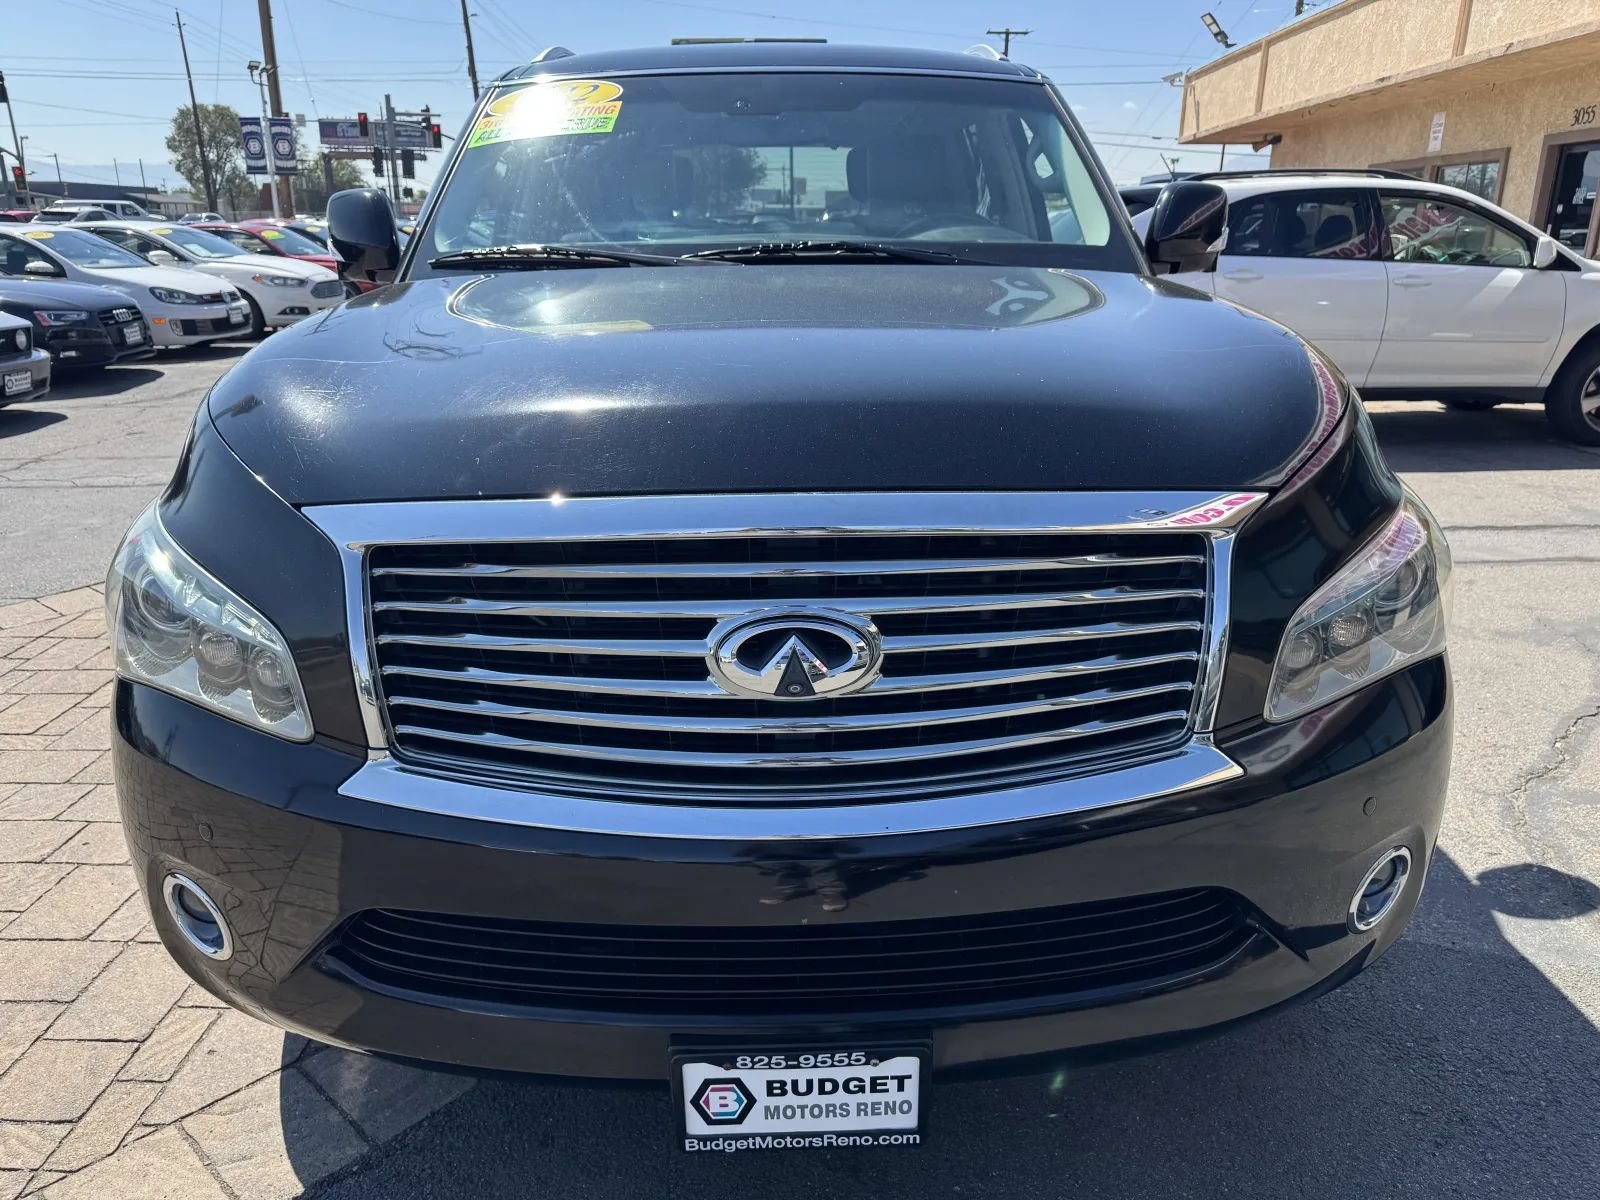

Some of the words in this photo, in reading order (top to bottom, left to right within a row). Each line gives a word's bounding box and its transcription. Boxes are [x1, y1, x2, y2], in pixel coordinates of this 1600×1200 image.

[570, 104, 616, 116] ATING
[1570, 104, 1597, 126] 3055
[735, 1052, 866, 1069] 825-9555
[766, 1075, 912, 1097] BUDGET
[764, 1103, 851, 1120] MOTORS
[856, 1099, 913, 1117] RENO
[685, 1133, 920, 1153] BudgetMotorsReno.com
